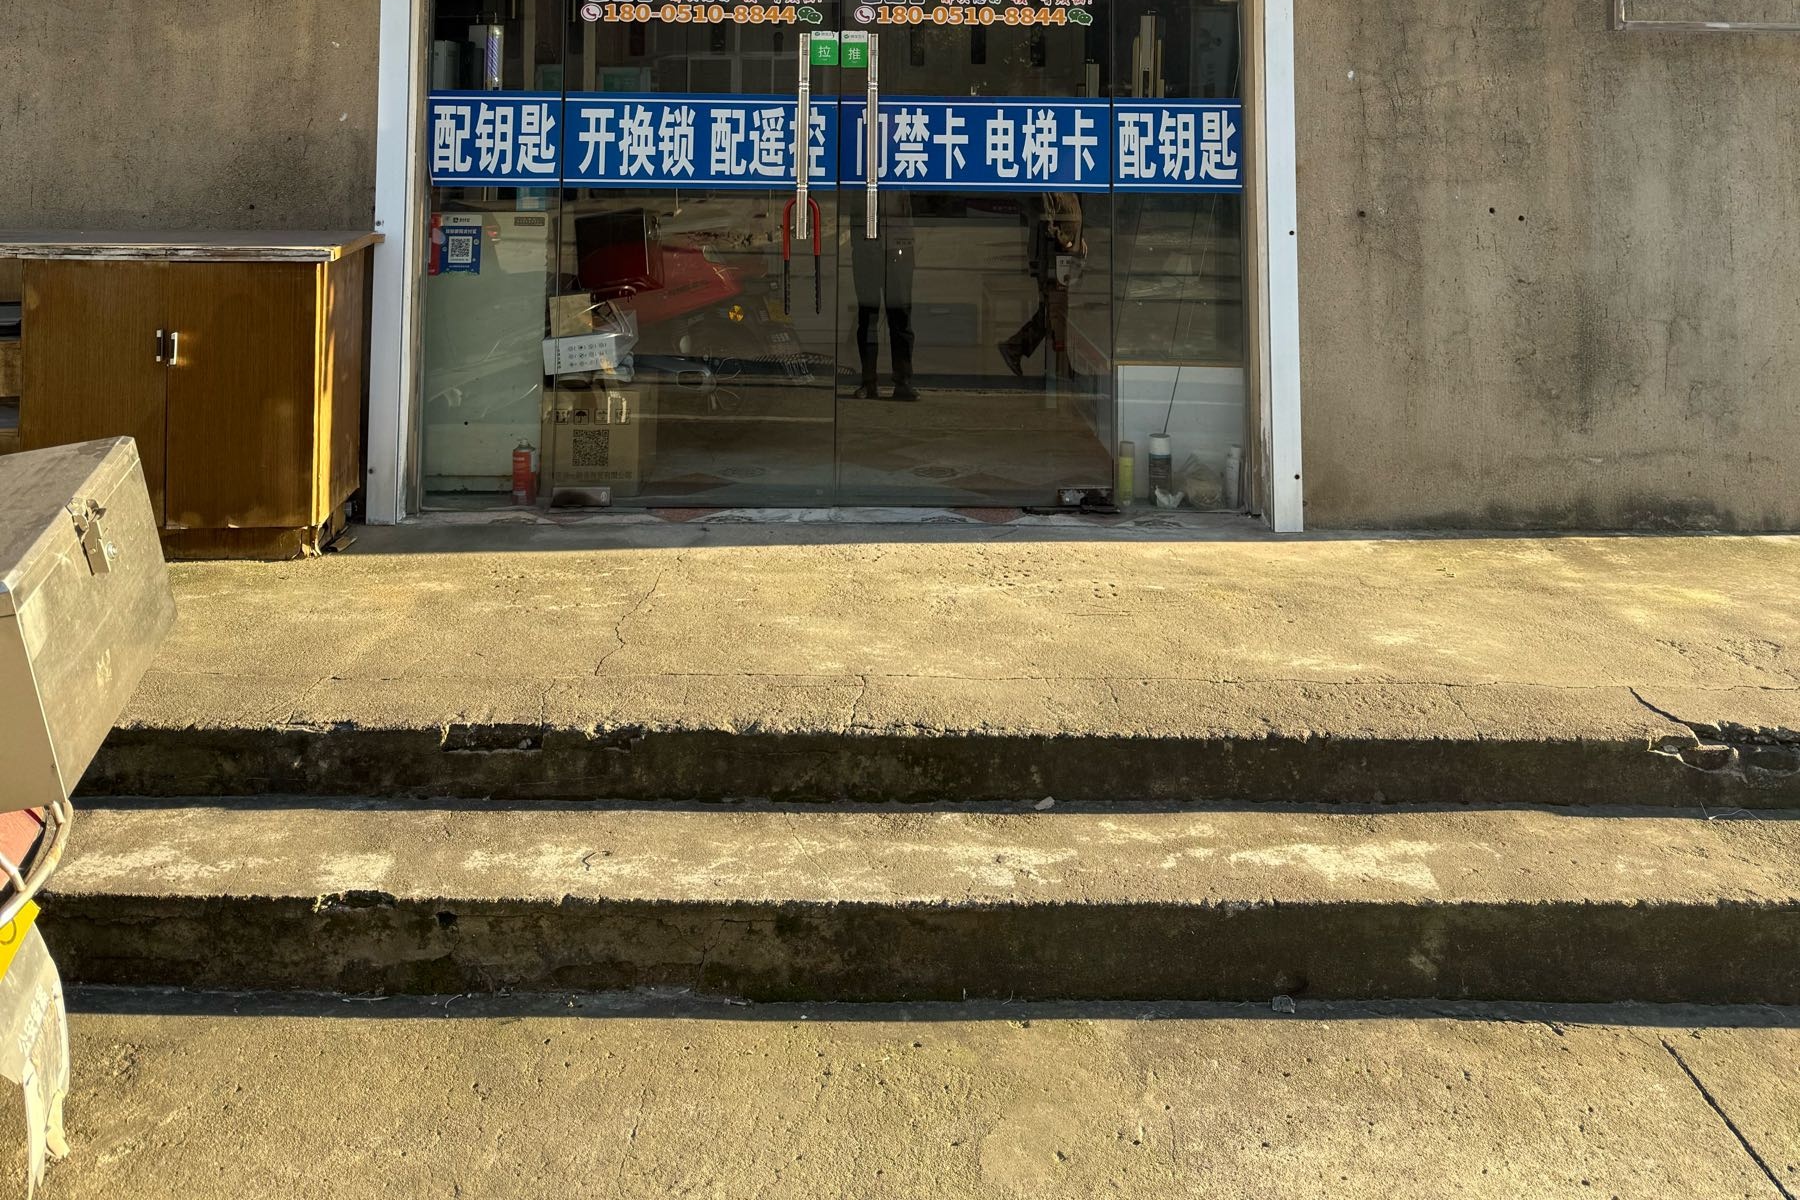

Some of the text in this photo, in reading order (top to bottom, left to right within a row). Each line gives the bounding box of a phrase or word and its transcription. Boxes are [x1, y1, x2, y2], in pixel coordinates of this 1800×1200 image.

[604, 3, 796, 24] 180-0510-8844
[876, 5, 1068, 26] 180-0510-8844
[817, 45, 831, 58] 拉
[848, 47, 861, 60] 推
[432, 102, 556, 175] 配钥匙
[578, 104, 826, 177] 开换锁 配遥控
[856, 108, 1098, 181] 门禁卡 电梯卡
[1118, 109, 1238, 182] 配钥匙
